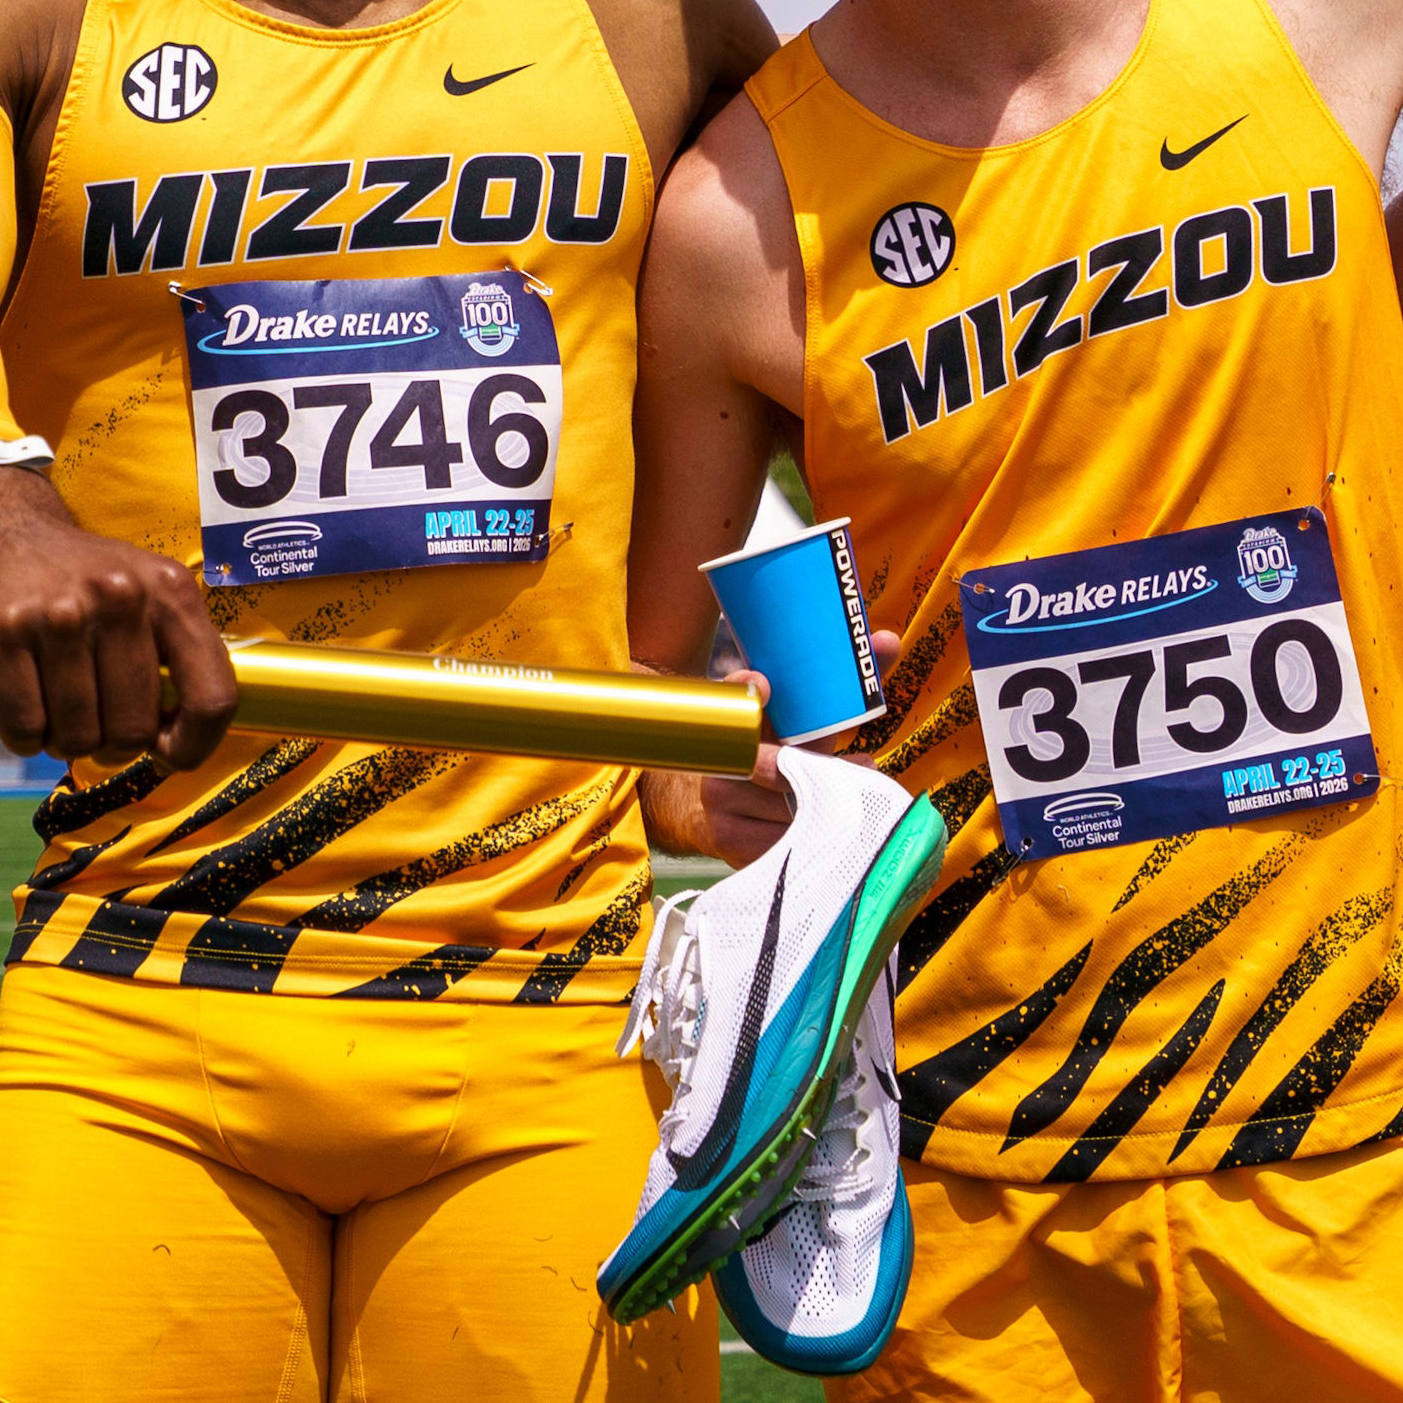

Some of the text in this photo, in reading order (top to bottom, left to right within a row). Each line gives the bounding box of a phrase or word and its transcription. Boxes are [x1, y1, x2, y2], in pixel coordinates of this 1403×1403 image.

[127, 45, 213, 120] SEC
[82, 151, 629, 278] MIZZOU
[873, 205, 952, 284] SEC
[222, 304, 337, 346] Drake
[468, 302, 508, 327] 100
[862, 185, 1338, 447] MIZZOU
[211, 373, 549, 509] 3746
[425, 508, 535, 539] APRIL 22-25
[250, 545, 318, 565] Continental
[427, 539, 507, 556] DRAKERELAYS.ORG
[513, 538, 531, 552] 2026
[1244, 545, 1285, 575] 100
[254, 562, 314, 577] Tour Silver
[831, 529, 879, 696] POWERADE
[1005, 582, 1116, 625] Drake
[433, 658, 554, 681] Champion
[998, 618, 1343, 783] 3750
[1221, 748, 1346, 798] APRIL 22-25
[1227, 786, 1313, 814] DRAKERELAYS.ORG
[1319, 777, 1349, 796] 2026
[1052, 815, 1122, 838] Continental
[1058, 831, 1120, 849] Tour Silver
